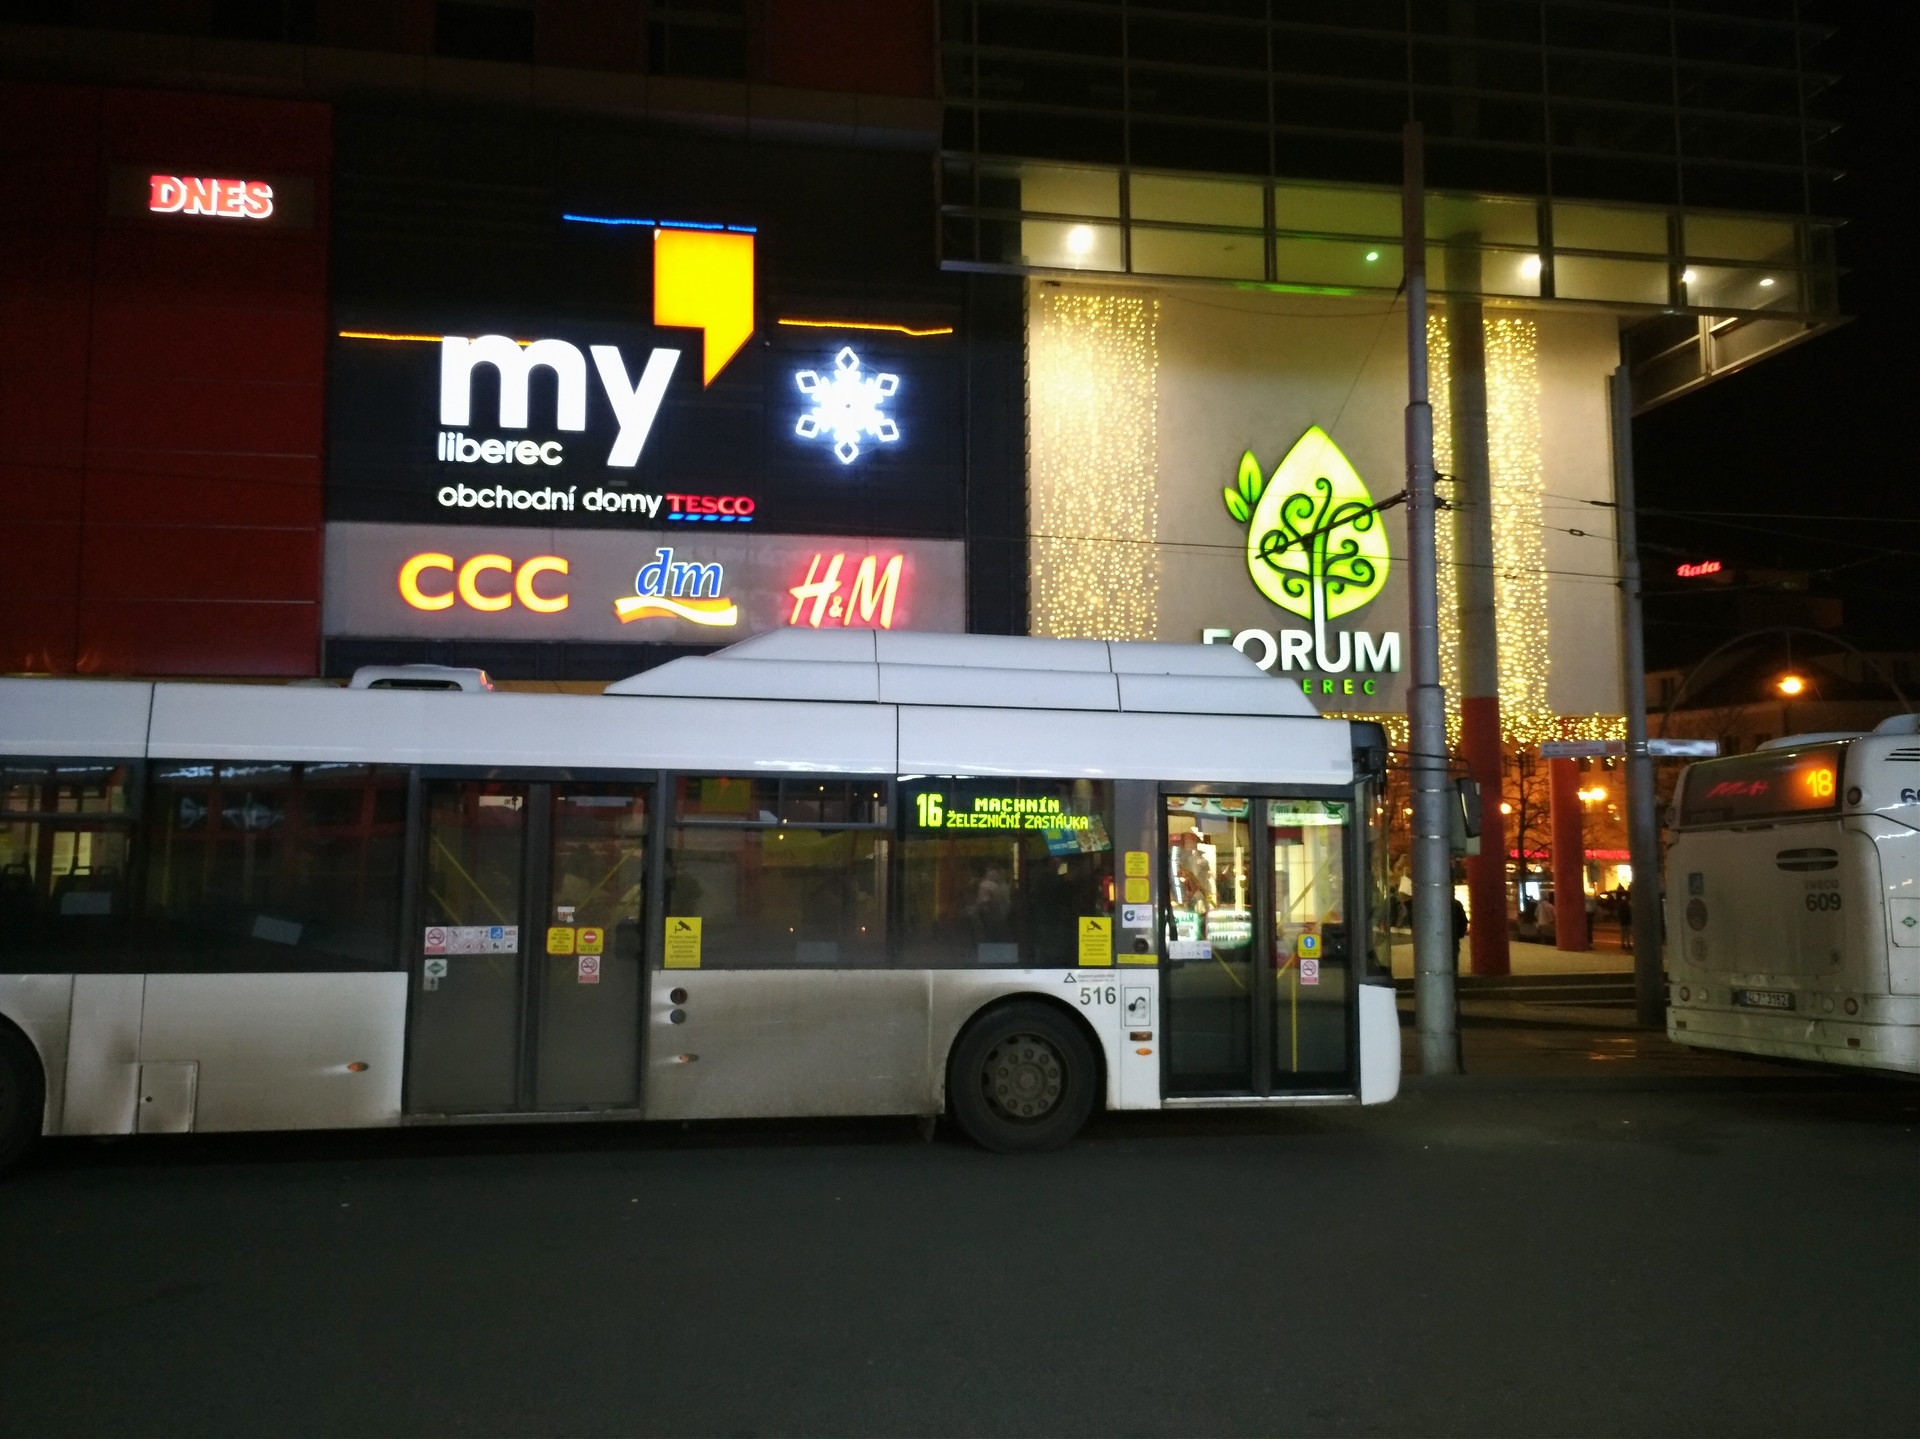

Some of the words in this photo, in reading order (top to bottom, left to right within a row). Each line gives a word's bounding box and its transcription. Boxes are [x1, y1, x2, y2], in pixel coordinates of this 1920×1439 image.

[149, 174, 273, 219] DNES
[440, 334, 681, 467] my
[438, 431, 563, 466] liberec
[437, 483, 577, 512] obchodní
[582, 487, 663, 519] domy
[666, 493, 755, 516] TESCO
[399, 552, 569, 613] CCC
[634, 546, 723, 598] dm
[789, 552, 904, 629] H&M
[1302, 678, 1377, 695] EREC
[1806, 769, 1833, 797] 18
[1901, 788, 1920, 807] 6
[916, 793, 943, 827] 16
[975, 796, 1060, 813] MACHNÍN
[946, 810, 1021, 828] ŽELEZNIČNÍ
[1024, 813, 1089, 830] ZASTÁVKA
[1805, 892, 1842, 912] 609
[1080, 986, 1116, 1005] 516
